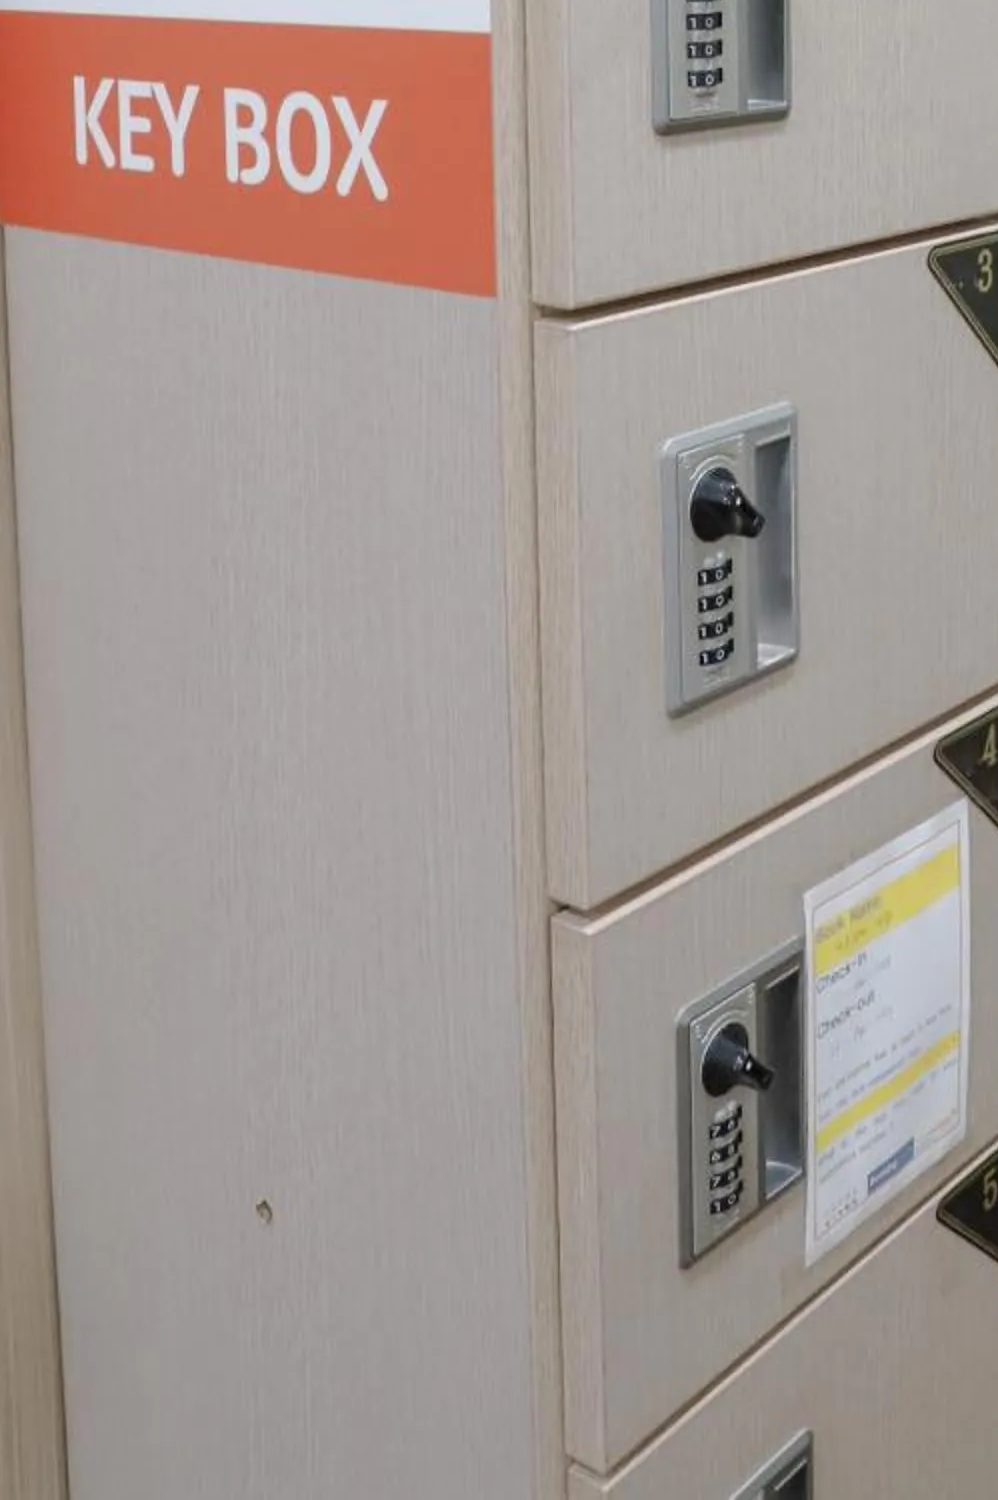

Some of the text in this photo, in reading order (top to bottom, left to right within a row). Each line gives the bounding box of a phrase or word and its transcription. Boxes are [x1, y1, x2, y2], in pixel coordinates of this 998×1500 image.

[73, 75, 390, 202] KEY BOX
[977, 248, 994, 293] 3
[979, 722, 998, 767] 4
[983, 1167, 998, 1212] 5
